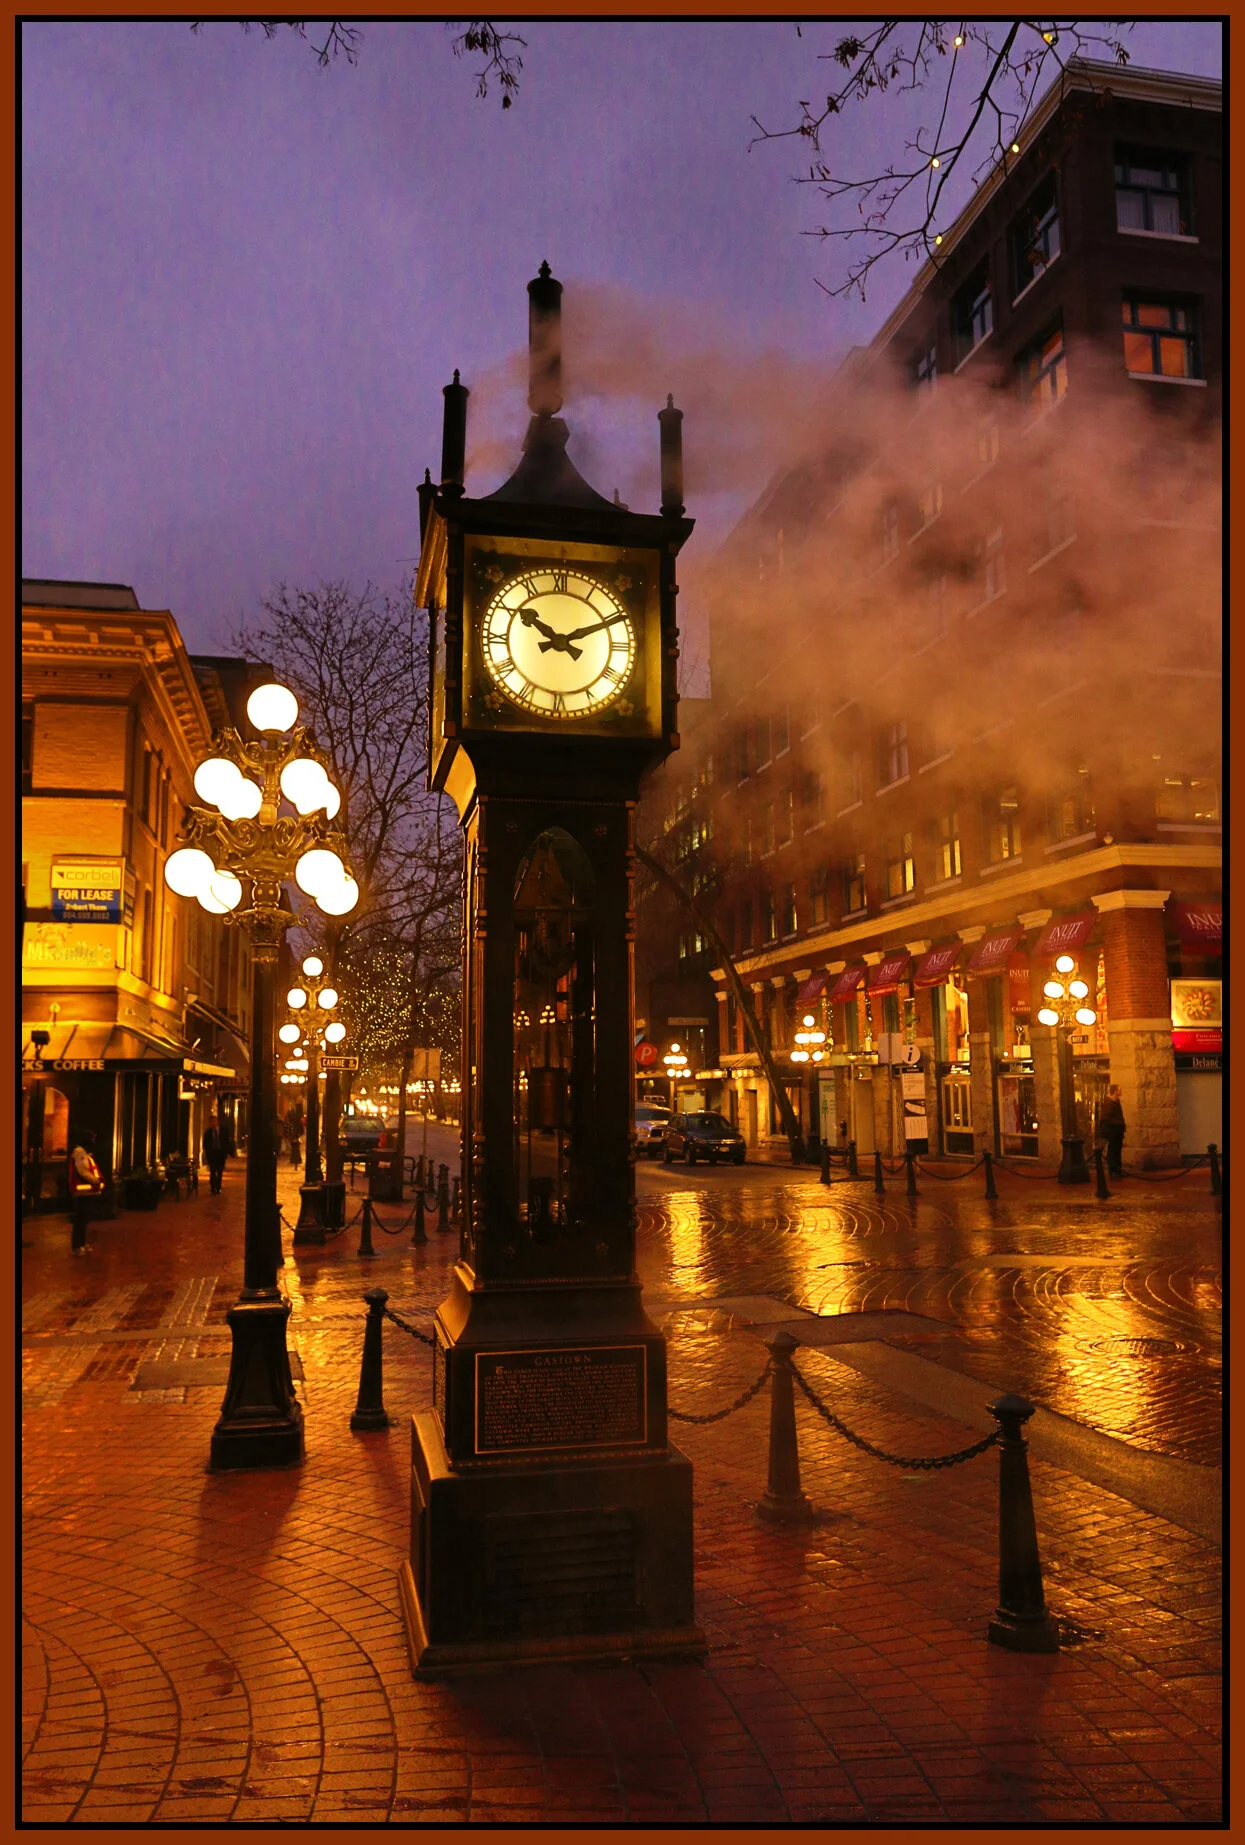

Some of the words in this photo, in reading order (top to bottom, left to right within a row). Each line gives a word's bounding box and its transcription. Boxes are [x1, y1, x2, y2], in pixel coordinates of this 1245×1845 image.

[66, 870, 114, 881] corbel
[58, 889, 79, 900] FOR
[81, 890, 114, 901] LEASE
[1049, 921, 1083, 939] INUIT
[1009, 969, 1029, 977] INUIT
[641, 1047, 651, 1061] P
[53, 1060, 105, 1071] COFFEE
[323, 1059, 345, 1067] CAMBIE
[534, 1355, 592, 1365] GASTOWN
